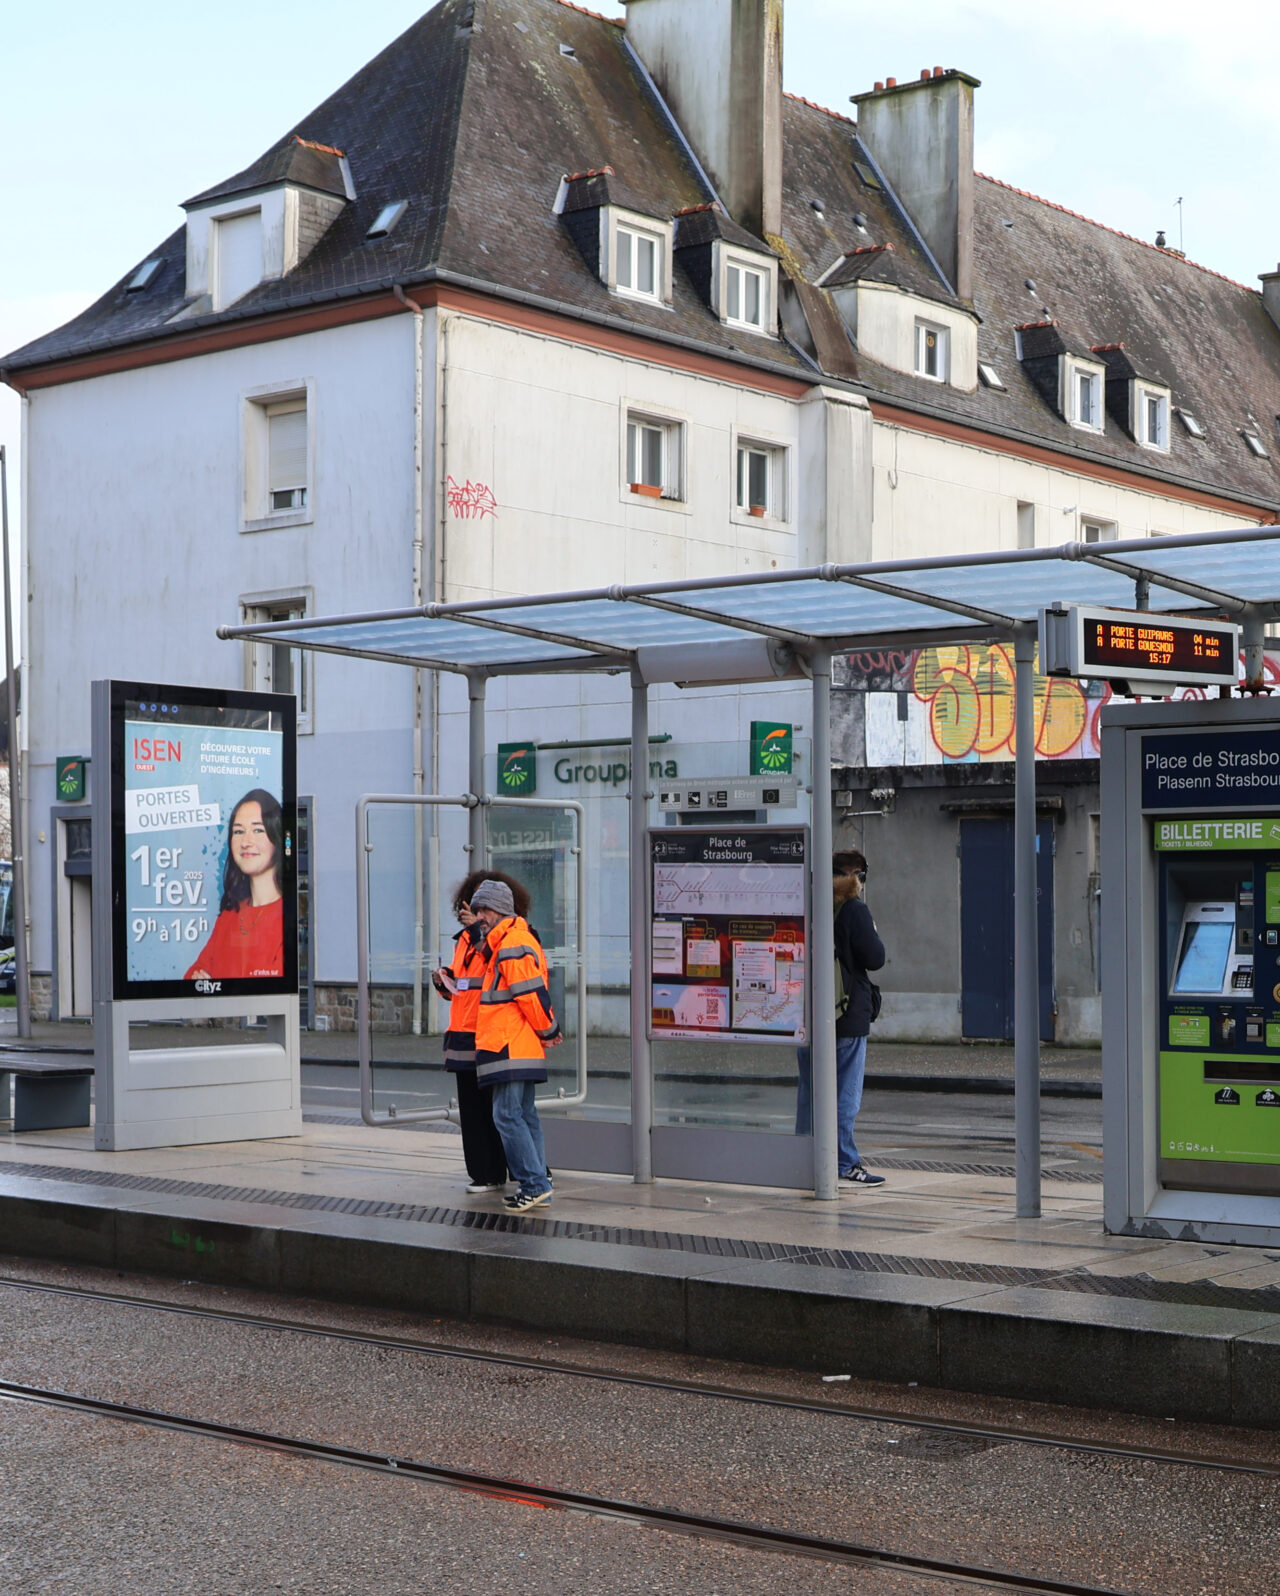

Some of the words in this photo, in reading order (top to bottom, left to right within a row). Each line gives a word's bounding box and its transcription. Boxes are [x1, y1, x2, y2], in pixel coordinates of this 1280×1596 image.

[1097, 624, 1103, 635] A
[1110, 626, 1134, 638] PORTE
[1138, 627, 1174, 642] GUIPAVAS
[1193, 634, 1203, 644] 04
[1205, 637, 1219, 646] min
[1097, 636, 1103, 647] A
[1111, 637, 1135, 650] PORTE
[1138, 639, 1174, 653] GOUESNOU
[1194, 646, 1203, 656] 11
[1205, 648, 1219, 657] min
[1149, 653, 1171, 664] 15:17
[133, 738, 182, 762] ISEN
[200, 742, 247, 755] DÉCOUVREZ
[248, 746, 271, 755] VOTRE
[200, 754, 229, 764] FUTURE
[231, 755, 256, 765] ÉCOLE
[1146, 753, 1187, 770] Place
[1192, 752, 1213, 768] de
[554, 758, 678, 786] Groupma
[1158, 775, 1211, 790] Plasenn
[136, 790, 191, 807] PORTES
[138, 809, 212, 828] OUVERTES
[1160, 822, 1264, 841] BILLETTERIE
[709, 837, 733, 848] Place
[735, 837, 746, 848] de
[703, 849, 753, 861] Strasbourg
[184, 871, 203, 880] 2025
[132, 917, 157, 942] 9h
[160, 925, 169, 941] à
[171, 917, 208, 941] 16h
[195, 980, 222, 993] Cityz
